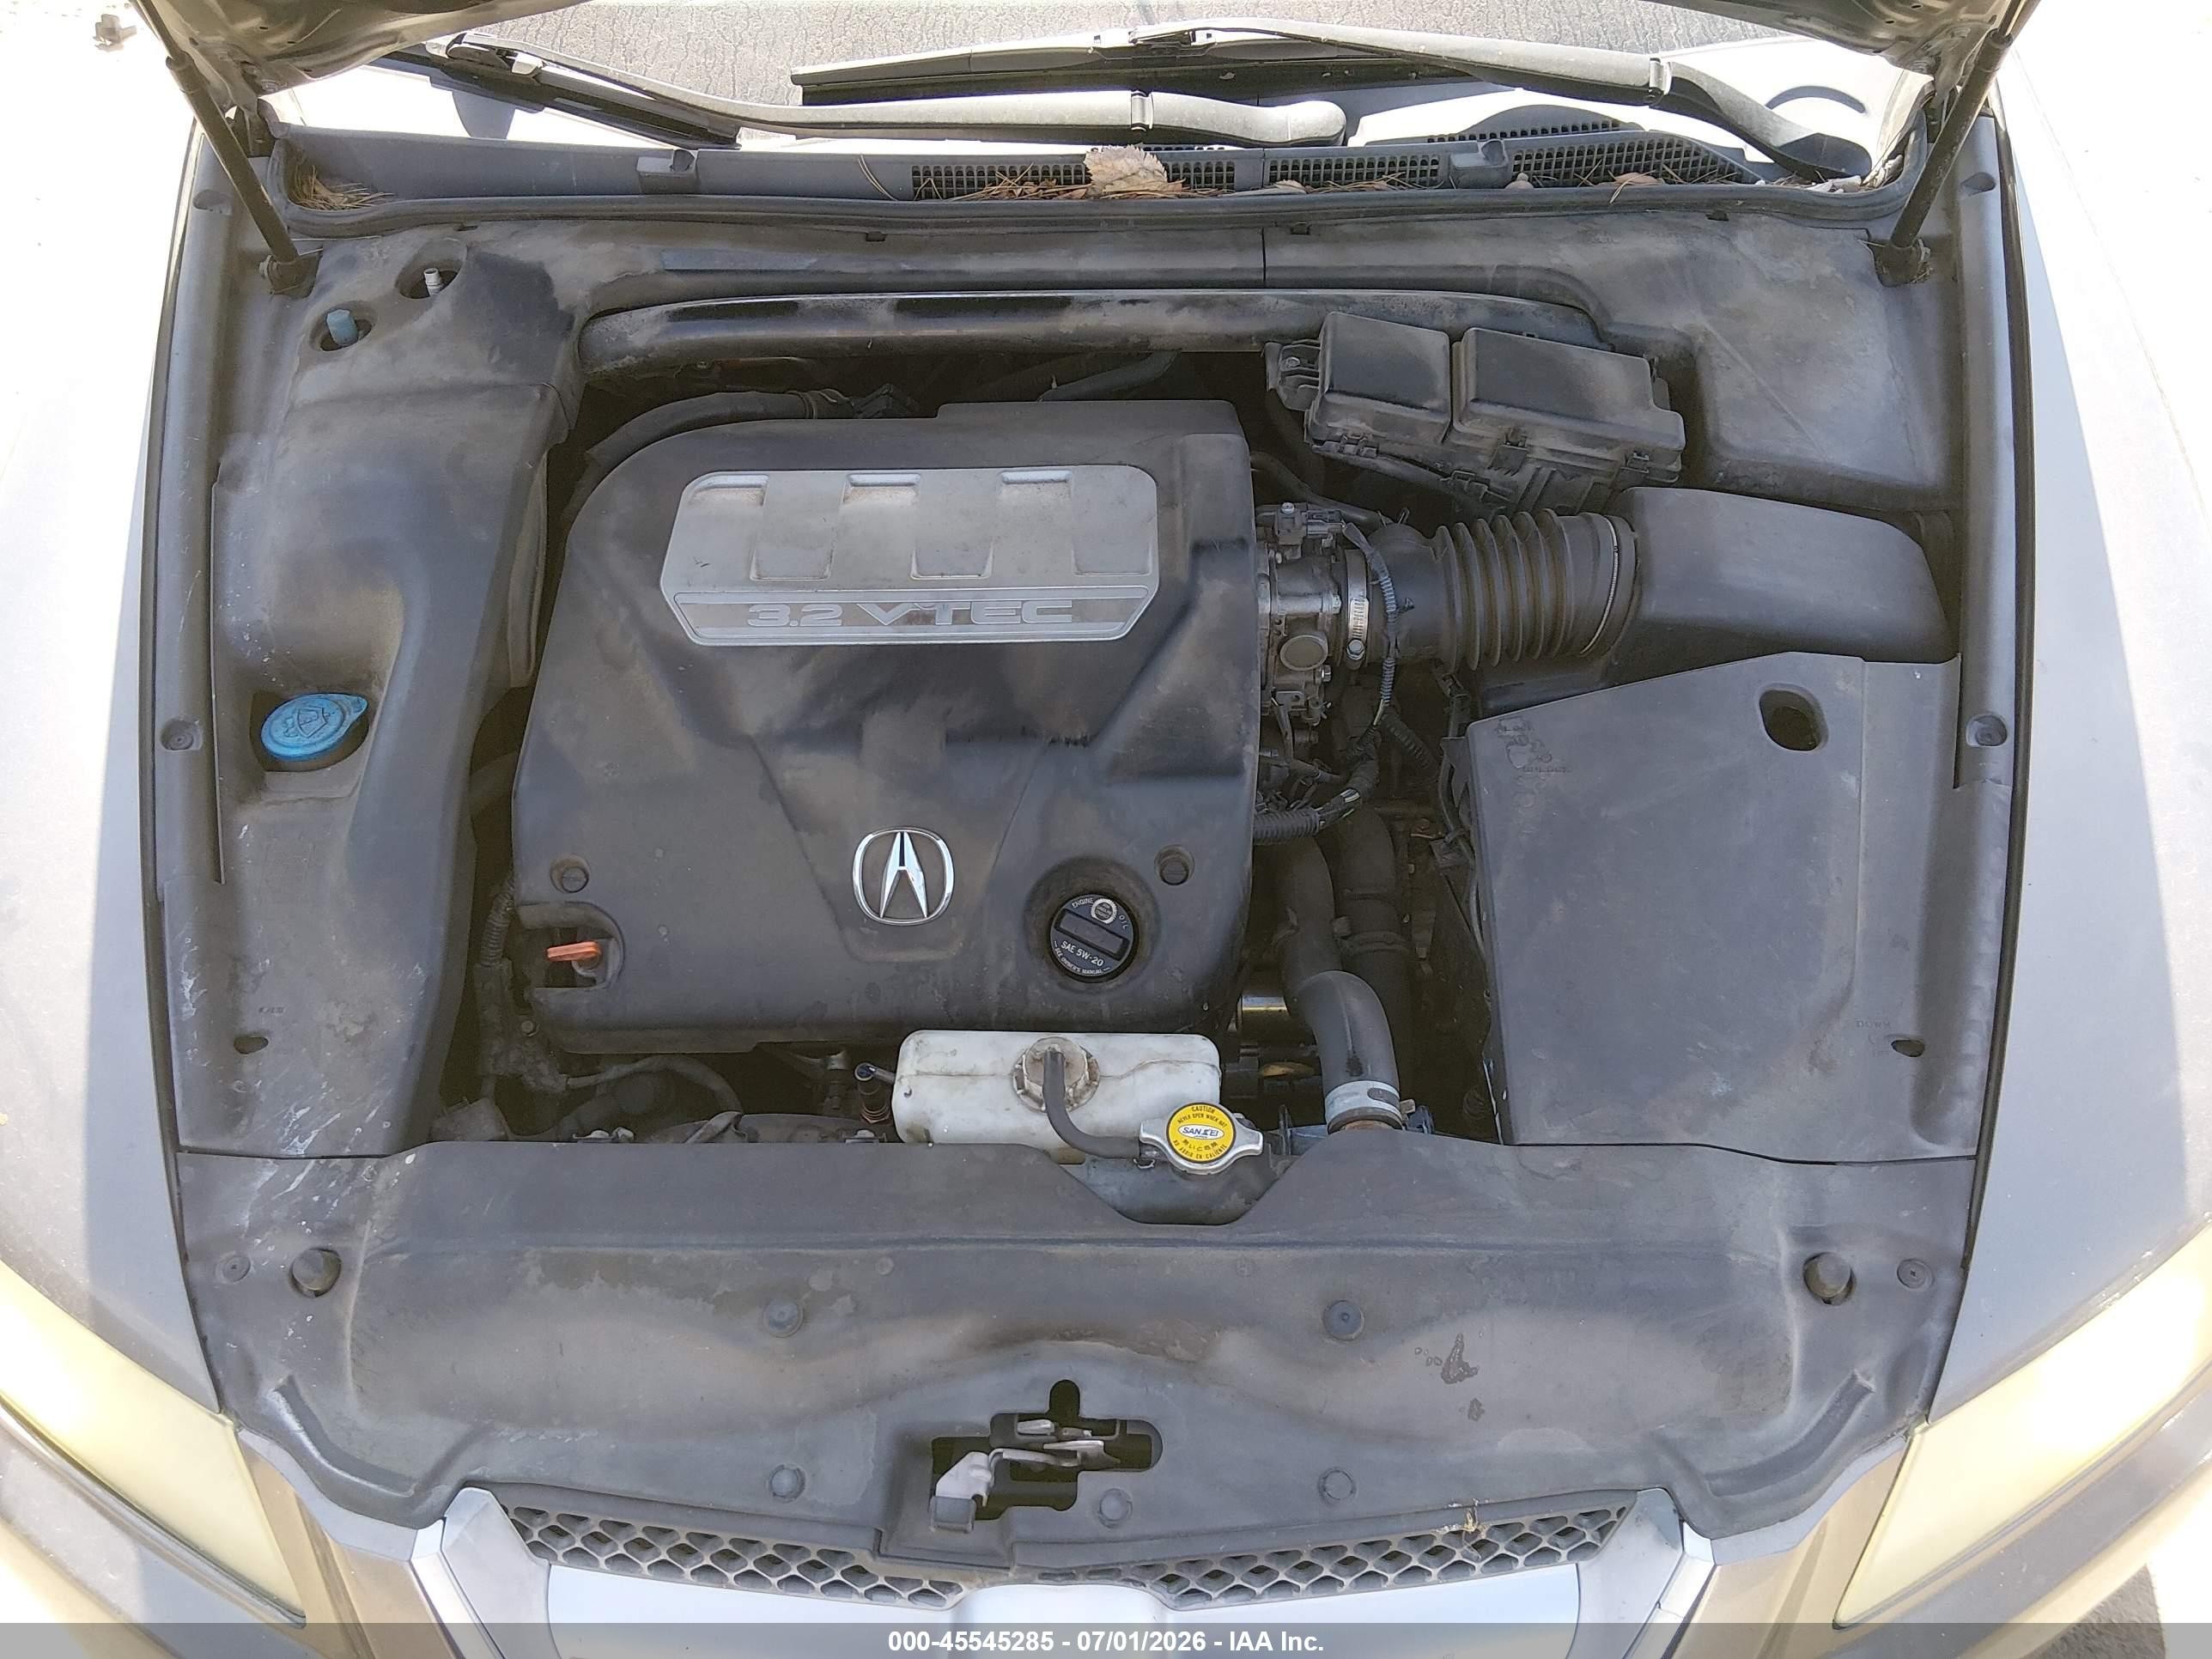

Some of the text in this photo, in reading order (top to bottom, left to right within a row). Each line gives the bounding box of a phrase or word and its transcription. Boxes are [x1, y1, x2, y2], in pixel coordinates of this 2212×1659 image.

[748, 601, 1072, 627] 3.2 VTEC
[1072, 897, 1128, 929] ENGINE OIL
[1060, 940, 1104, 967] SAE 5W-20
[1177, 1115, 1191, 1123] NEVER
[1191, 1105, 1216, 1114] CAUTION
